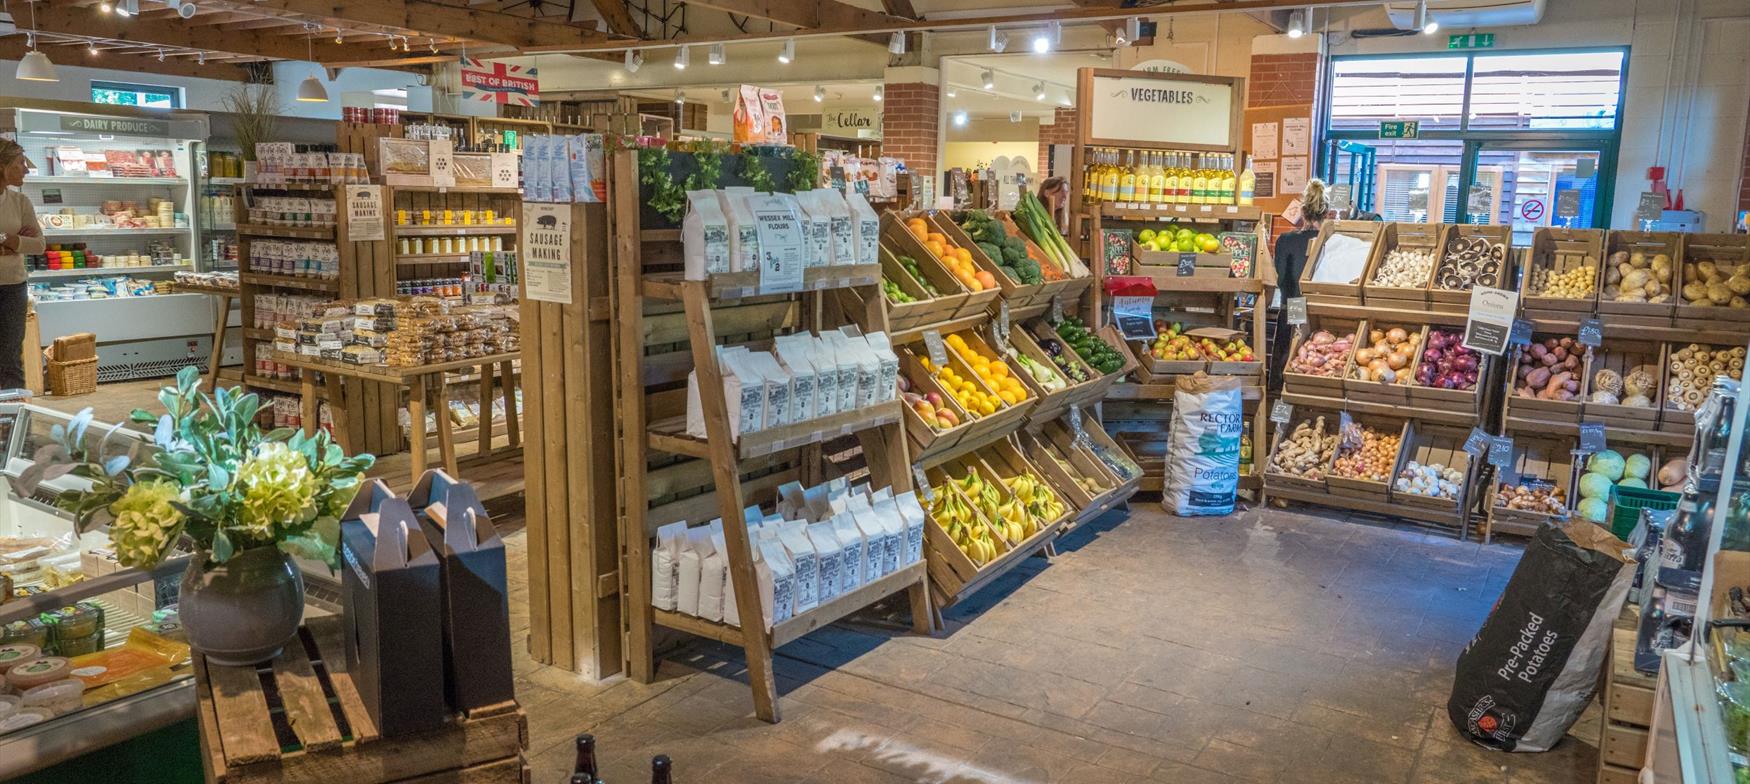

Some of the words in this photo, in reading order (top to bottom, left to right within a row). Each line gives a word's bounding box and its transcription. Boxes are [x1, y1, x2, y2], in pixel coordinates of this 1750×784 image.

[465, 73, 487, 85] BEST
[488, 77, 500, 86] OF
[502, 79, 535, 91] BRITISH
[1131, 87, 1193, 104] VEGETABLES
[84, 119, 108, 130] DAIRY
[111, 121, 149, 133] PRODUCE
[837, 112, 871, 128] Cellar
[352, 200, 377, 209] SAUSAGE
[354, 209, 376, 217] MAKING
[759, 214, 781, 222] WESSEX
[768, 223, 790, 231] FLOURS
[529, 231, 563, 246] SAUSAGE
[532, 247, 561, 261] MAKING
[766, 251, 772, 261] 3
[774, 262, 780, 272] 2
[1497, 611, 1544, 681] Pre-Packed
[1518, 630, 1558, 683] Potatoes
